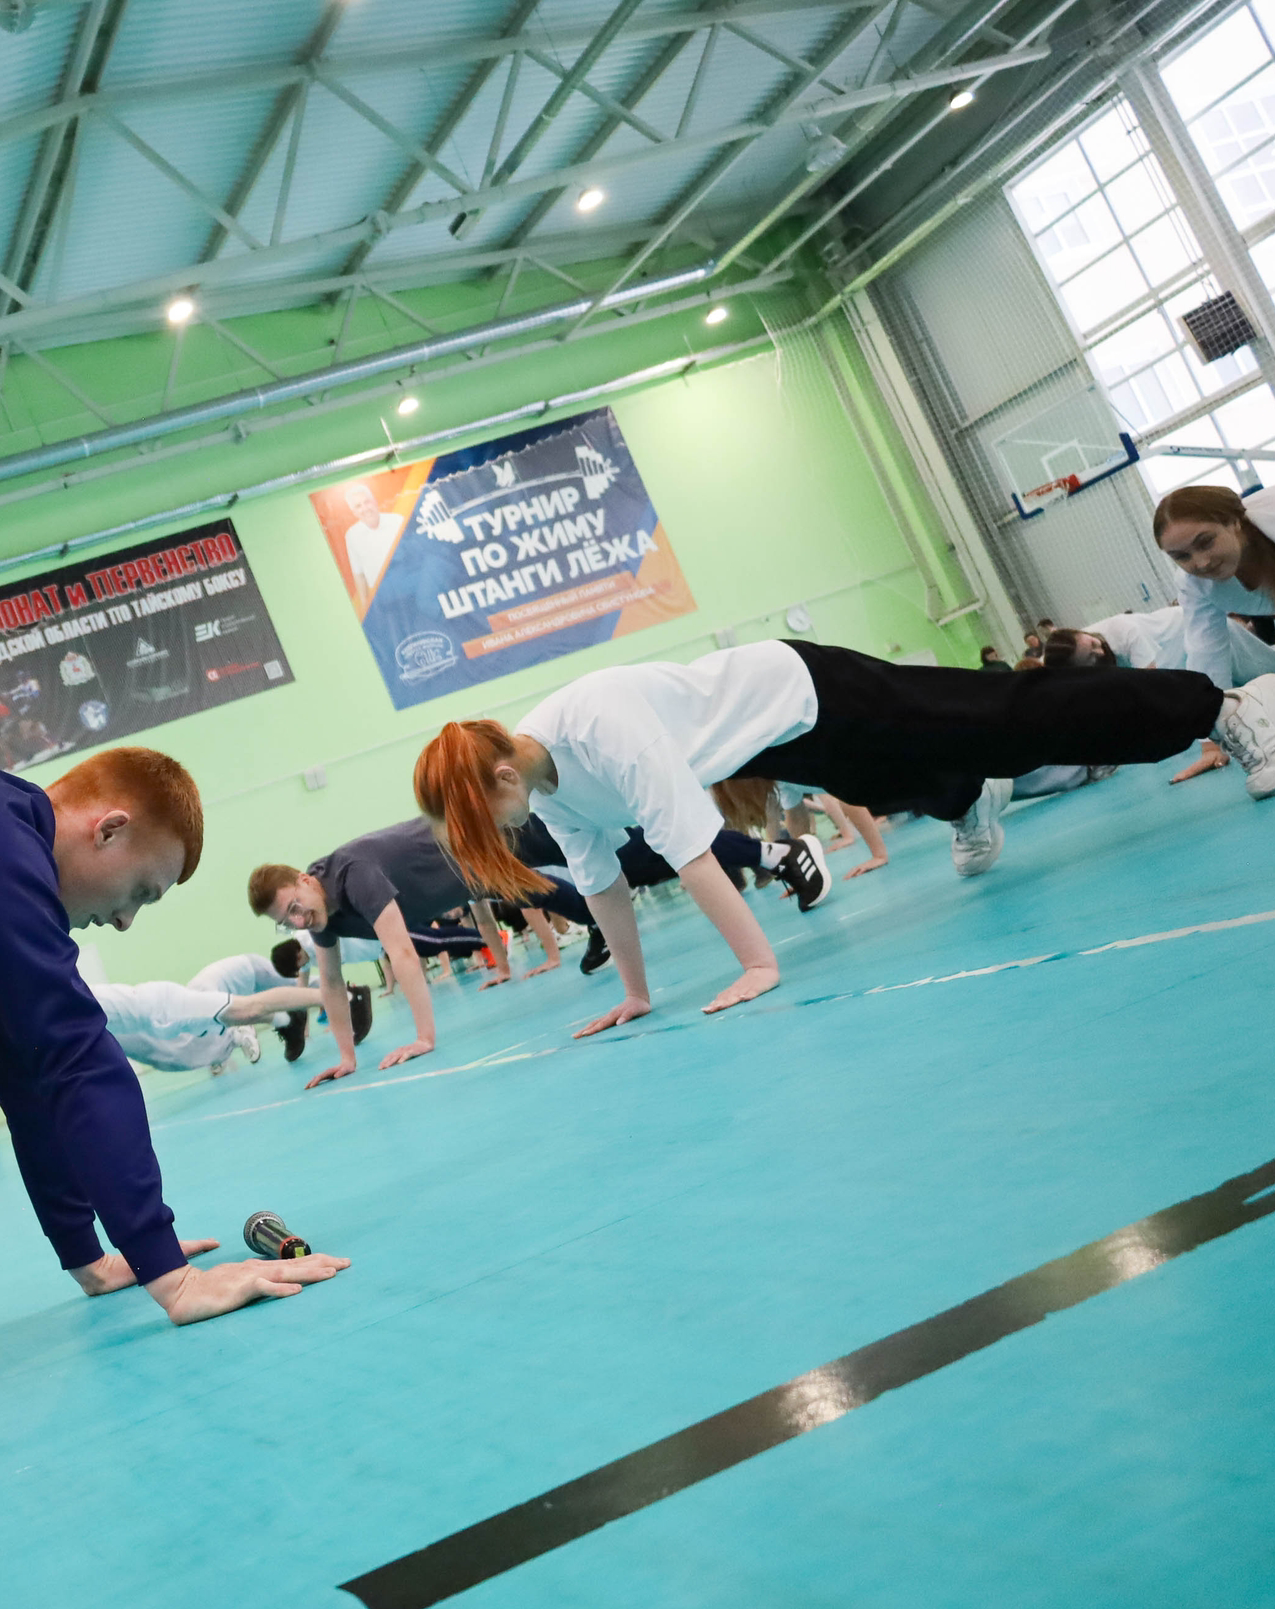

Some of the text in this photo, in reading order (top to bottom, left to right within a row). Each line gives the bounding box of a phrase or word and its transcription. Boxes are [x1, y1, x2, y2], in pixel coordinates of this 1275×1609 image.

[460, 508, 606, 577] ПО ЖИМУ
[463, 486, 580, 541] ТУРНИР
[85, 533, 238, 602] ПЕРВЕНСТВО
[437, 529, 658, 619] ШТАНГИ ЛЁЖА
[44, 612, 109, 645] ОБЛАСТИ
[107, 603, 133, 625] ПО
[130, 581, 204, 618] ТАЙСКОМУ
[203, 567, 247, 596] БОКСУ
